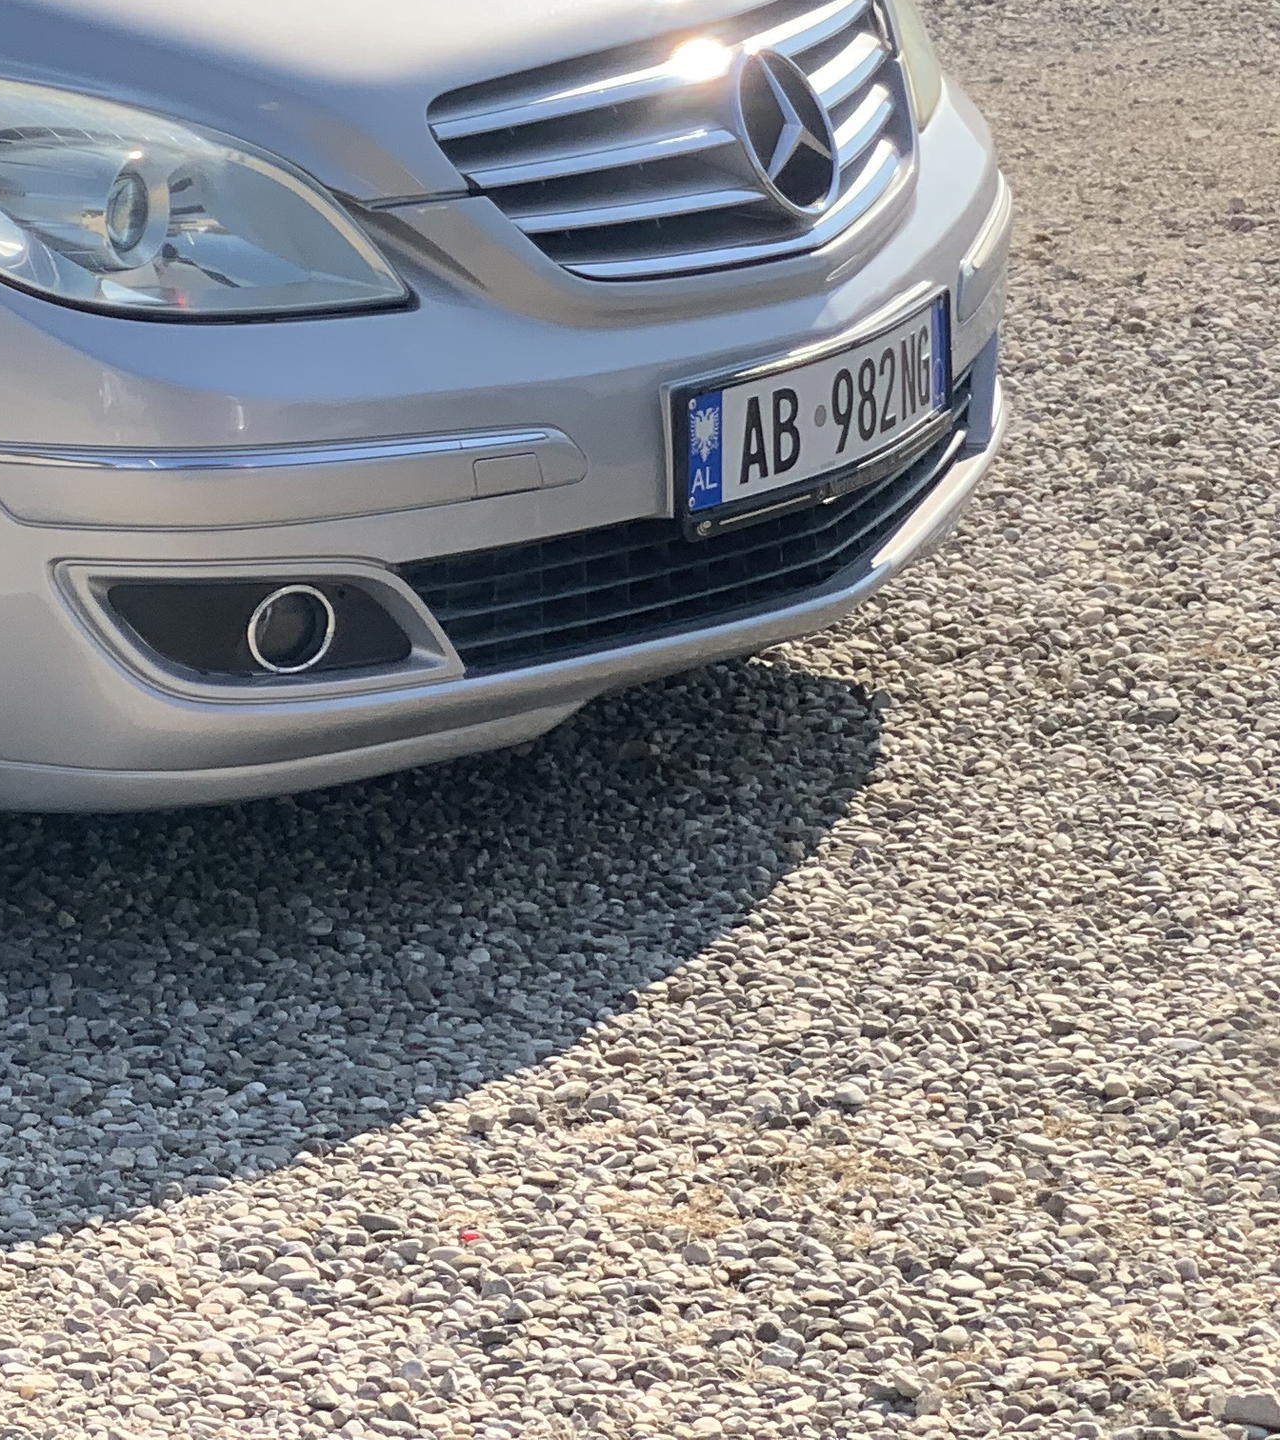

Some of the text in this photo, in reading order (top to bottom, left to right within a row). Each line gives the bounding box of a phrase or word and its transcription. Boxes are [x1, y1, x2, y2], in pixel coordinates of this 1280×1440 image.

[740, 387, 801, 485] AB
[831, 325, 930, 454] 982NG
[691, 466, 718, 494] AL
